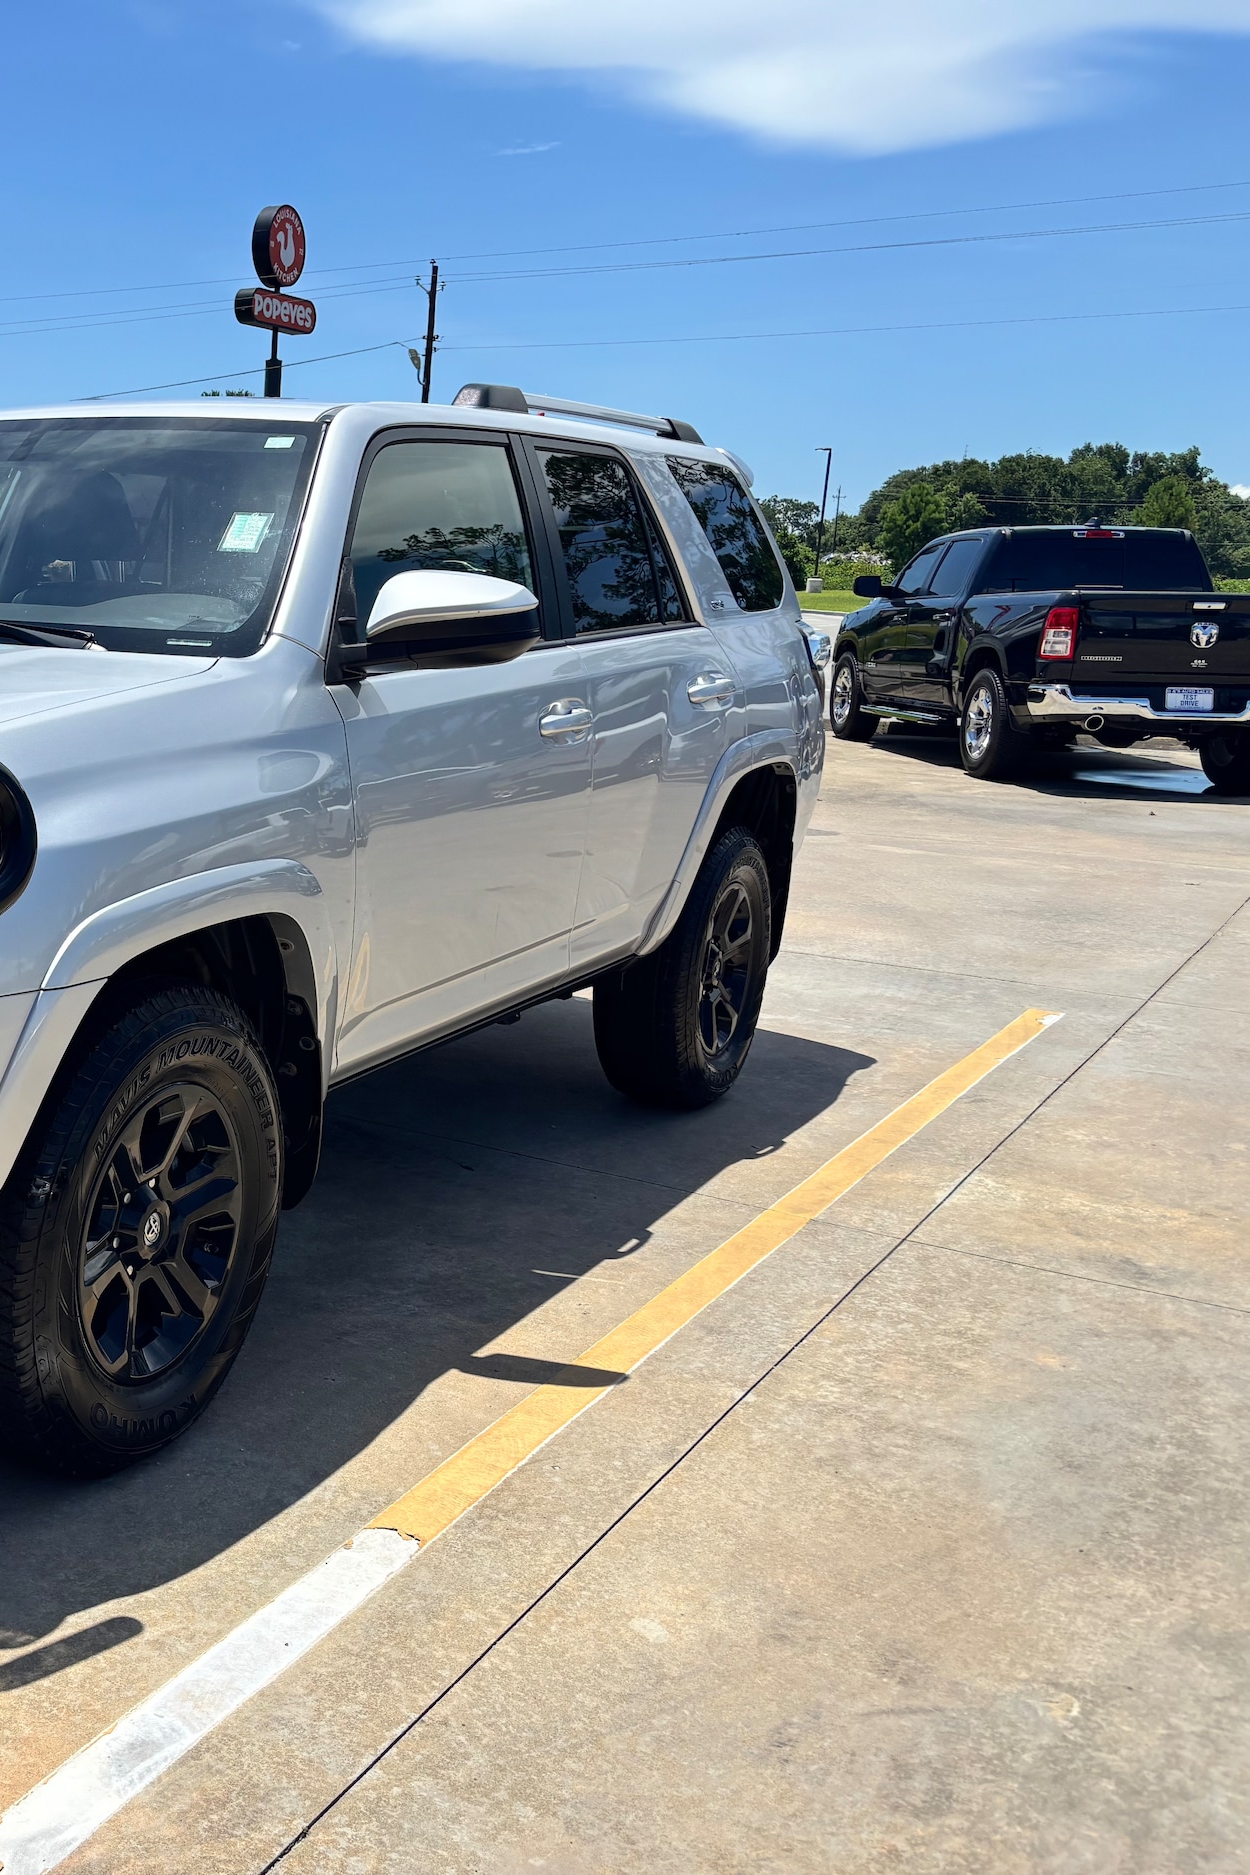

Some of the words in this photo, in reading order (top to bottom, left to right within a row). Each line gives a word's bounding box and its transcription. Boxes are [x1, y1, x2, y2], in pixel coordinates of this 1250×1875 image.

[273, 209, 302, 235] LOUISIANA
[273, 262, 300, 283] KITCHEN
[92, 1062, 152, 1162] MAVIS
[155, 1035, 275, 1132] MOUNTAINEER
[90, 1392, 199, 1437] KUMHO
